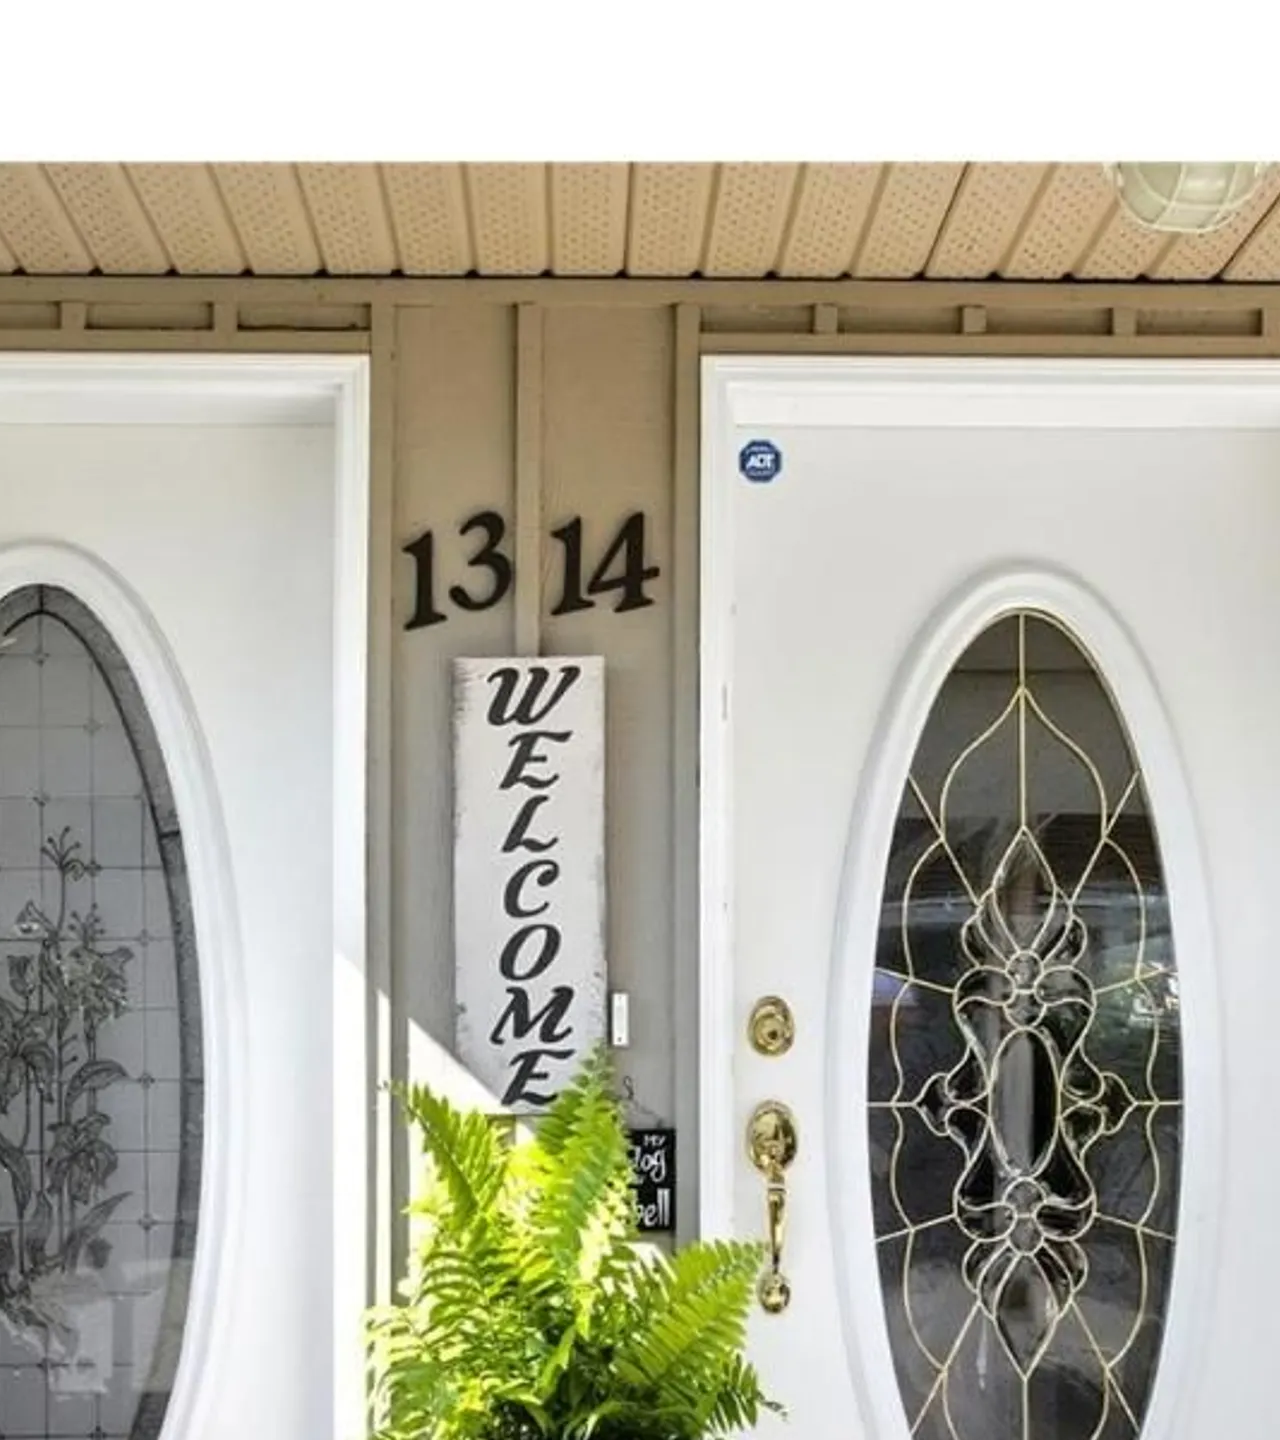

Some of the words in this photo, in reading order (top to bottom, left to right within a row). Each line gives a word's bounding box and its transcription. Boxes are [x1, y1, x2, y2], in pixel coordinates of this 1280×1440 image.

[402, 510, 514, 632] 13
[550, 510, 660, 616] 14
[485, 665, 582, 1108] WELCOME
